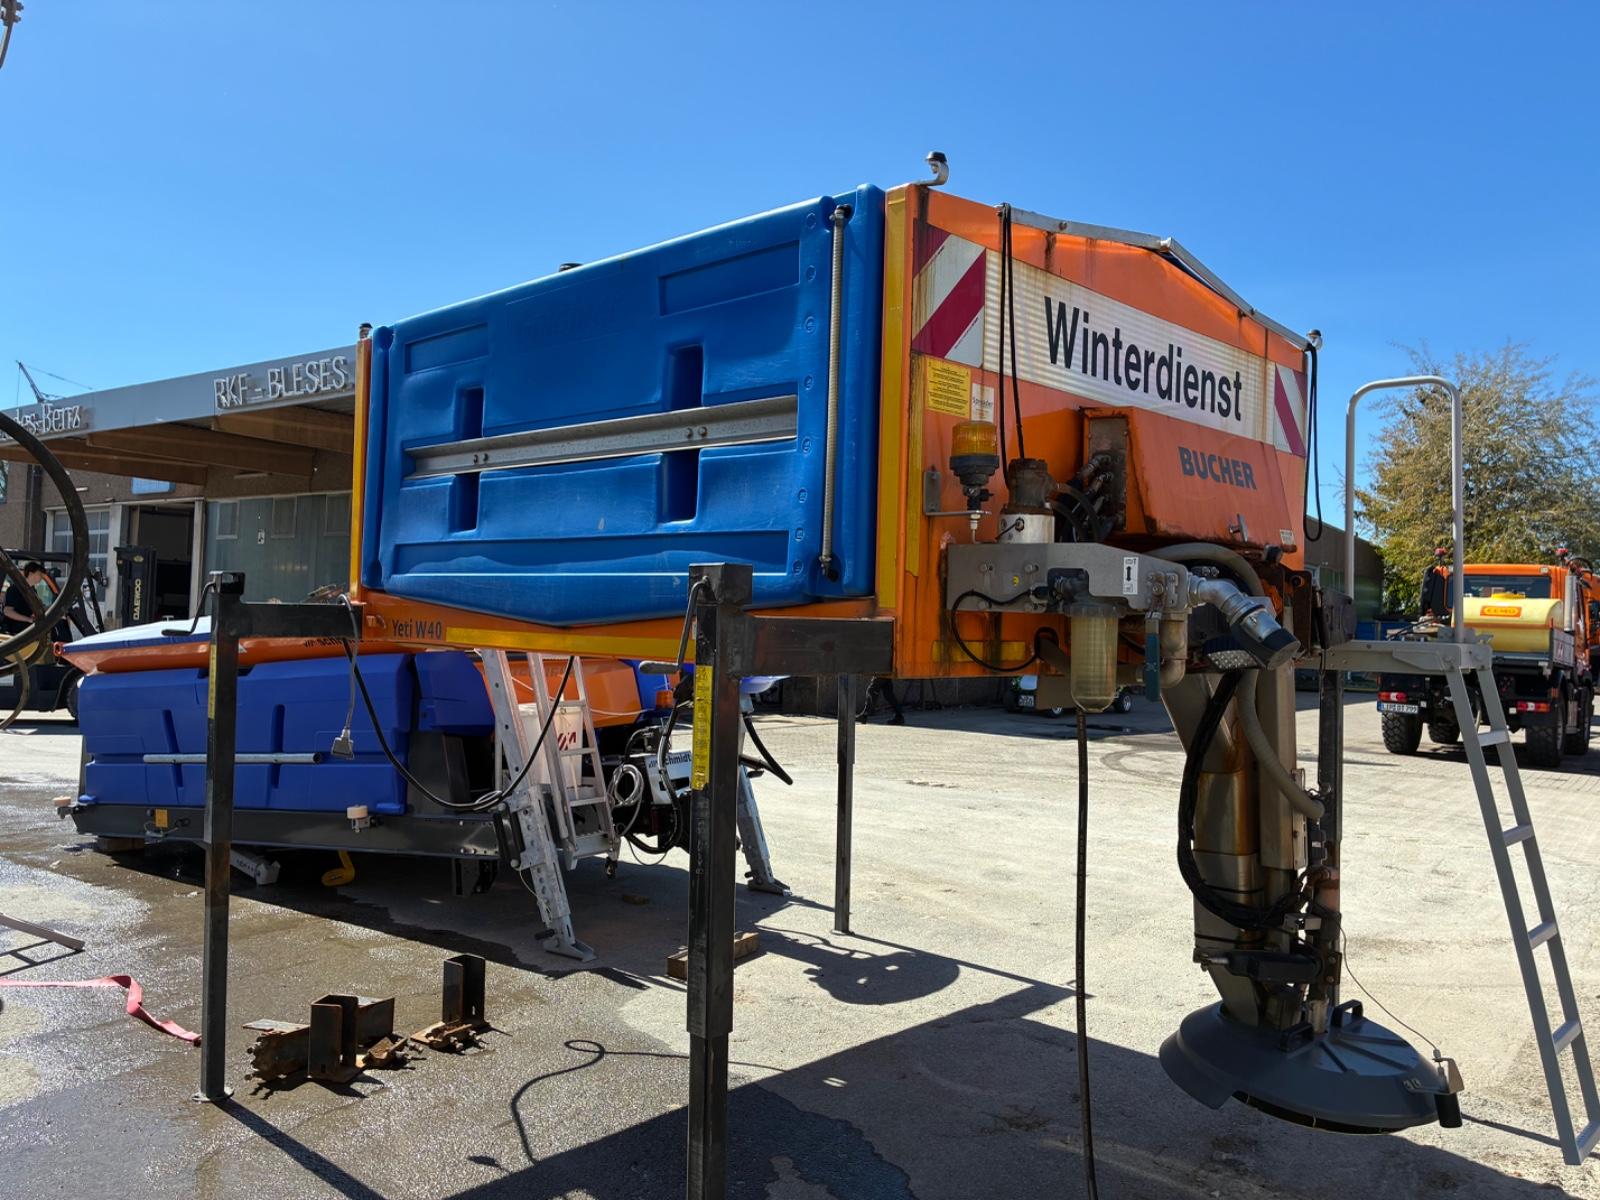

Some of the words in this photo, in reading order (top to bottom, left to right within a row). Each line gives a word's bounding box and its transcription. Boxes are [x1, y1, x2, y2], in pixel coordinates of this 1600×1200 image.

[267, 355, 347, 399] BLESES
[1044, 296, 1242, 421] Winterdienst
[1178, 446, 1257, 490] BUCHER
[132, 578, 142, 620] DAEWOO
[391, 619, 413, 639] Yeti
[415, 620, 442, 639] W40
